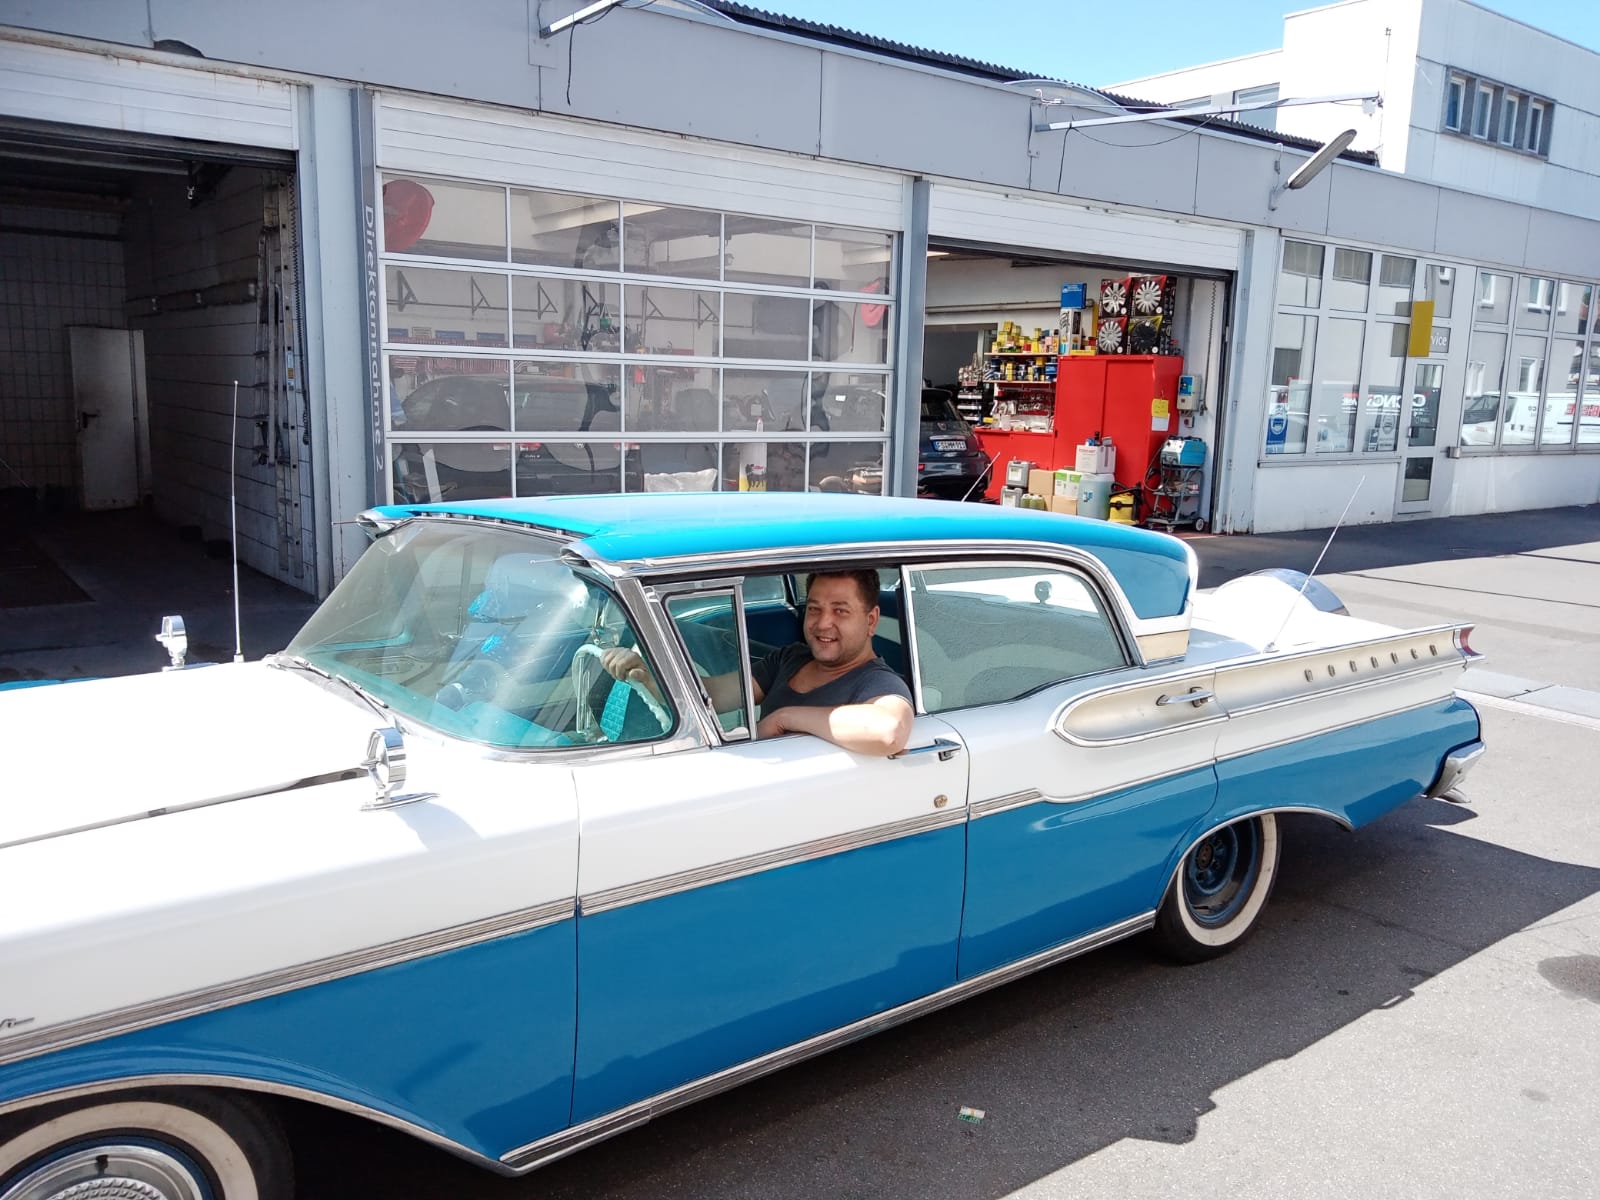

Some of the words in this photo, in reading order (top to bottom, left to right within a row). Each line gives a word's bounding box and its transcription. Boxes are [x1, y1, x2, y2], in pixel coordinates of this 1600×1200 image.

[366, 205, 382, 444] Direktannahme
[375, 455, 384, 473] 2
[1430, 332, 1448, 346] vice
